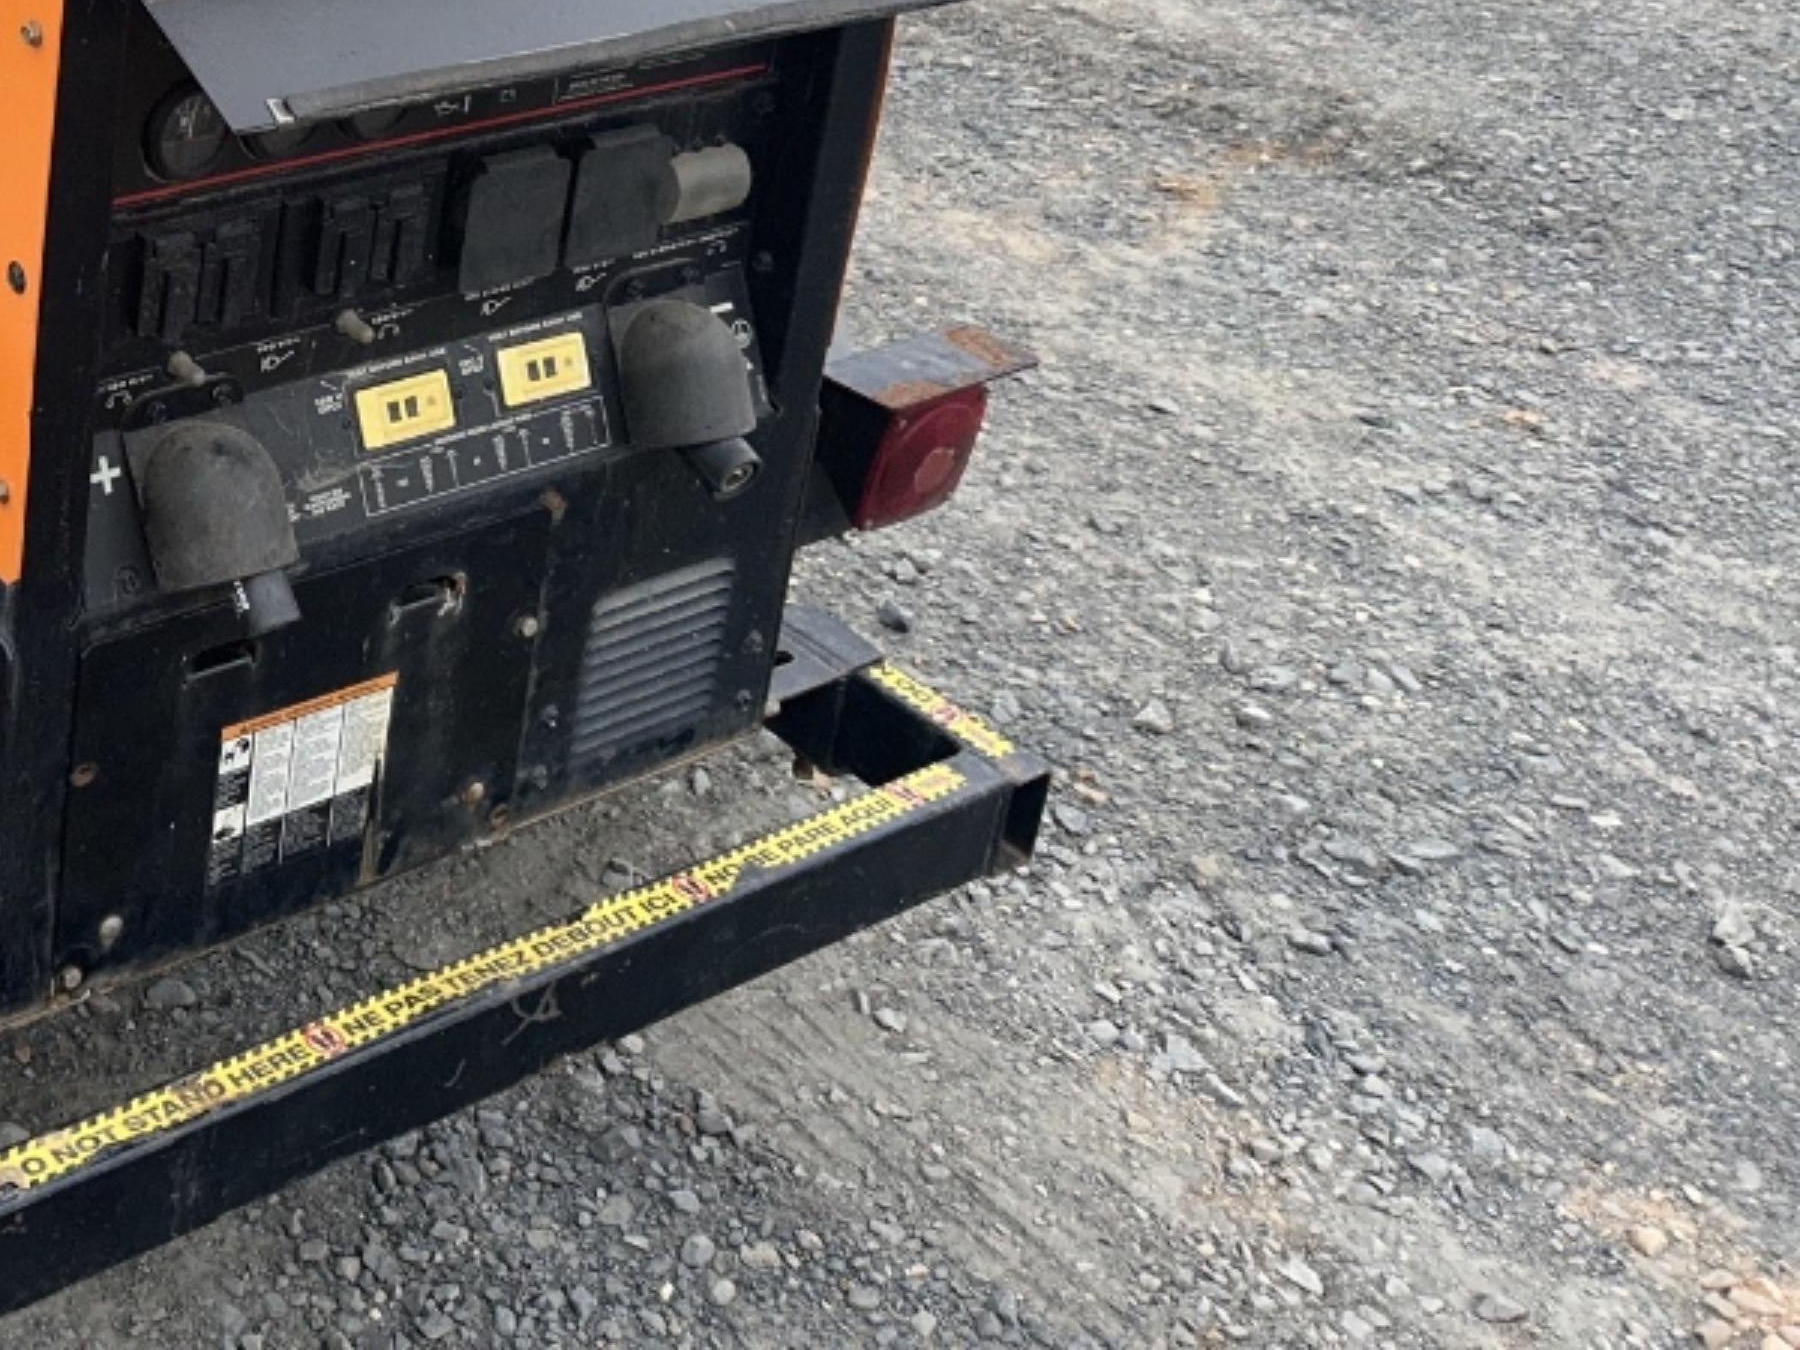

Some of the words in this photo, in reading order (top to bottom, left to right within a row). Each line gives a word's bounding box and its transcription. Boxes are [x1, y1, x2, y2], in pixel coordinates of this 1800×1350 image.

[50, 1124, 116, 1164] NOT
[122, 1078, 226, 1132] STAND
[227, 1042, 312, 1088] HERE
[341, 1011, 385, 1036] NE
[382, 984, 443, 1017] PAS
[530, 906, 638, 958] DEBOUT
[638, 892, 678, 914] ICI
[776, 820, 841, 854] PARE
